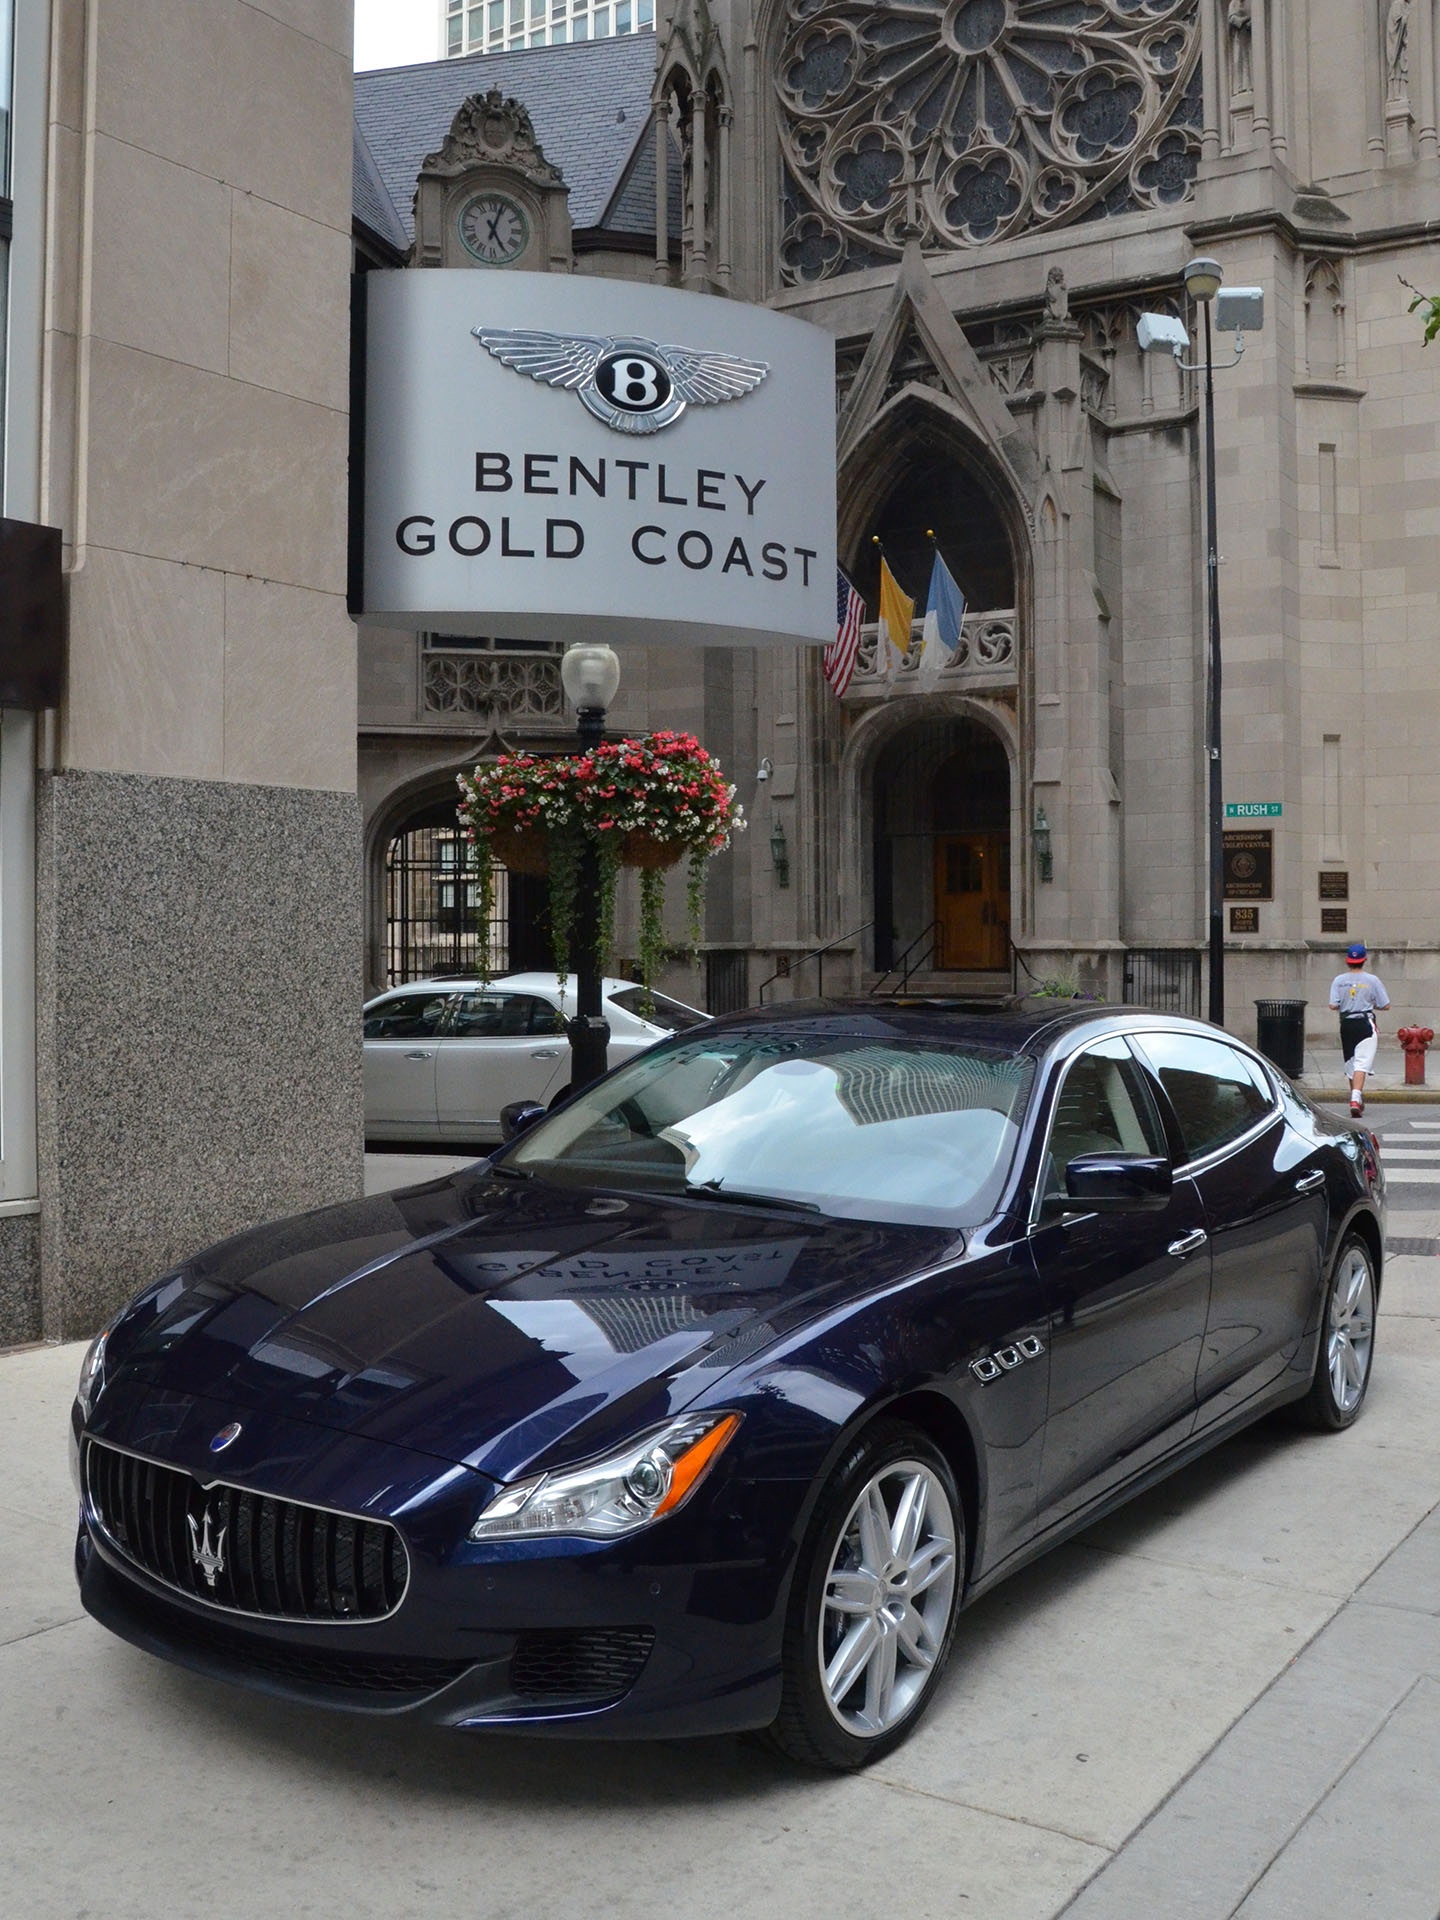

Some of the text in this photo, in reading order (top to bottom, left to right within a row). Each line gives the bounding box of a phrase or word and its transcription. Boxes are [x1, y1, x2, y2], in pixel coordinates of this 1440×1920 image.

[611, 358, 659, 406] B
[475, 452, 767, 516] BENTLEY
[396, 515, 817, 586] GOLD COAST
[1237, 804, 1268, 815] RUSH
[1235, 909, 1253, 919] 835
